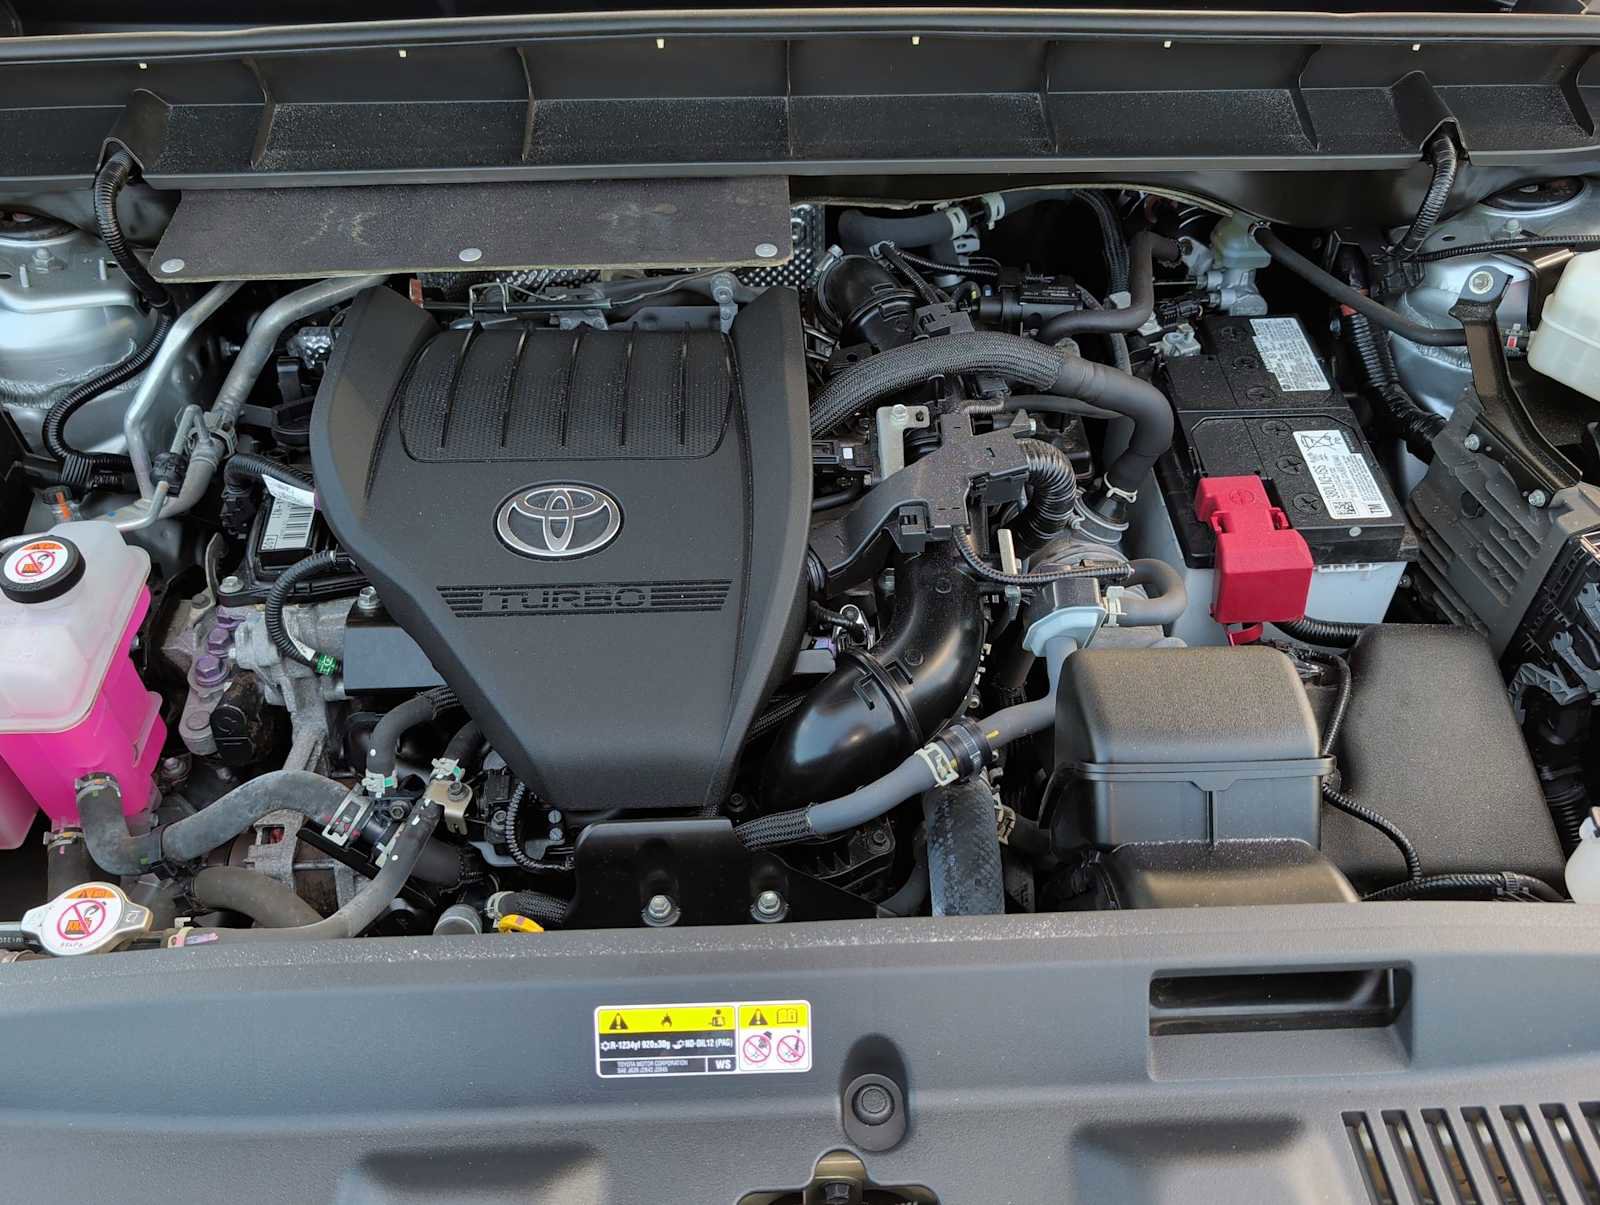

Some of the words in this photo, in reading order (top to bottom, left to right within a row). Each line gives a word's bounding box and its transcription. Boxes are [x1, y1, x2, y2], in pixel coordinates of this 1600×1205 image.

[488, 587, 647, 610] TURBO
[609, 1040, 641, 1051] R-1234yf
[715, 1059, 732, 1070] WS
